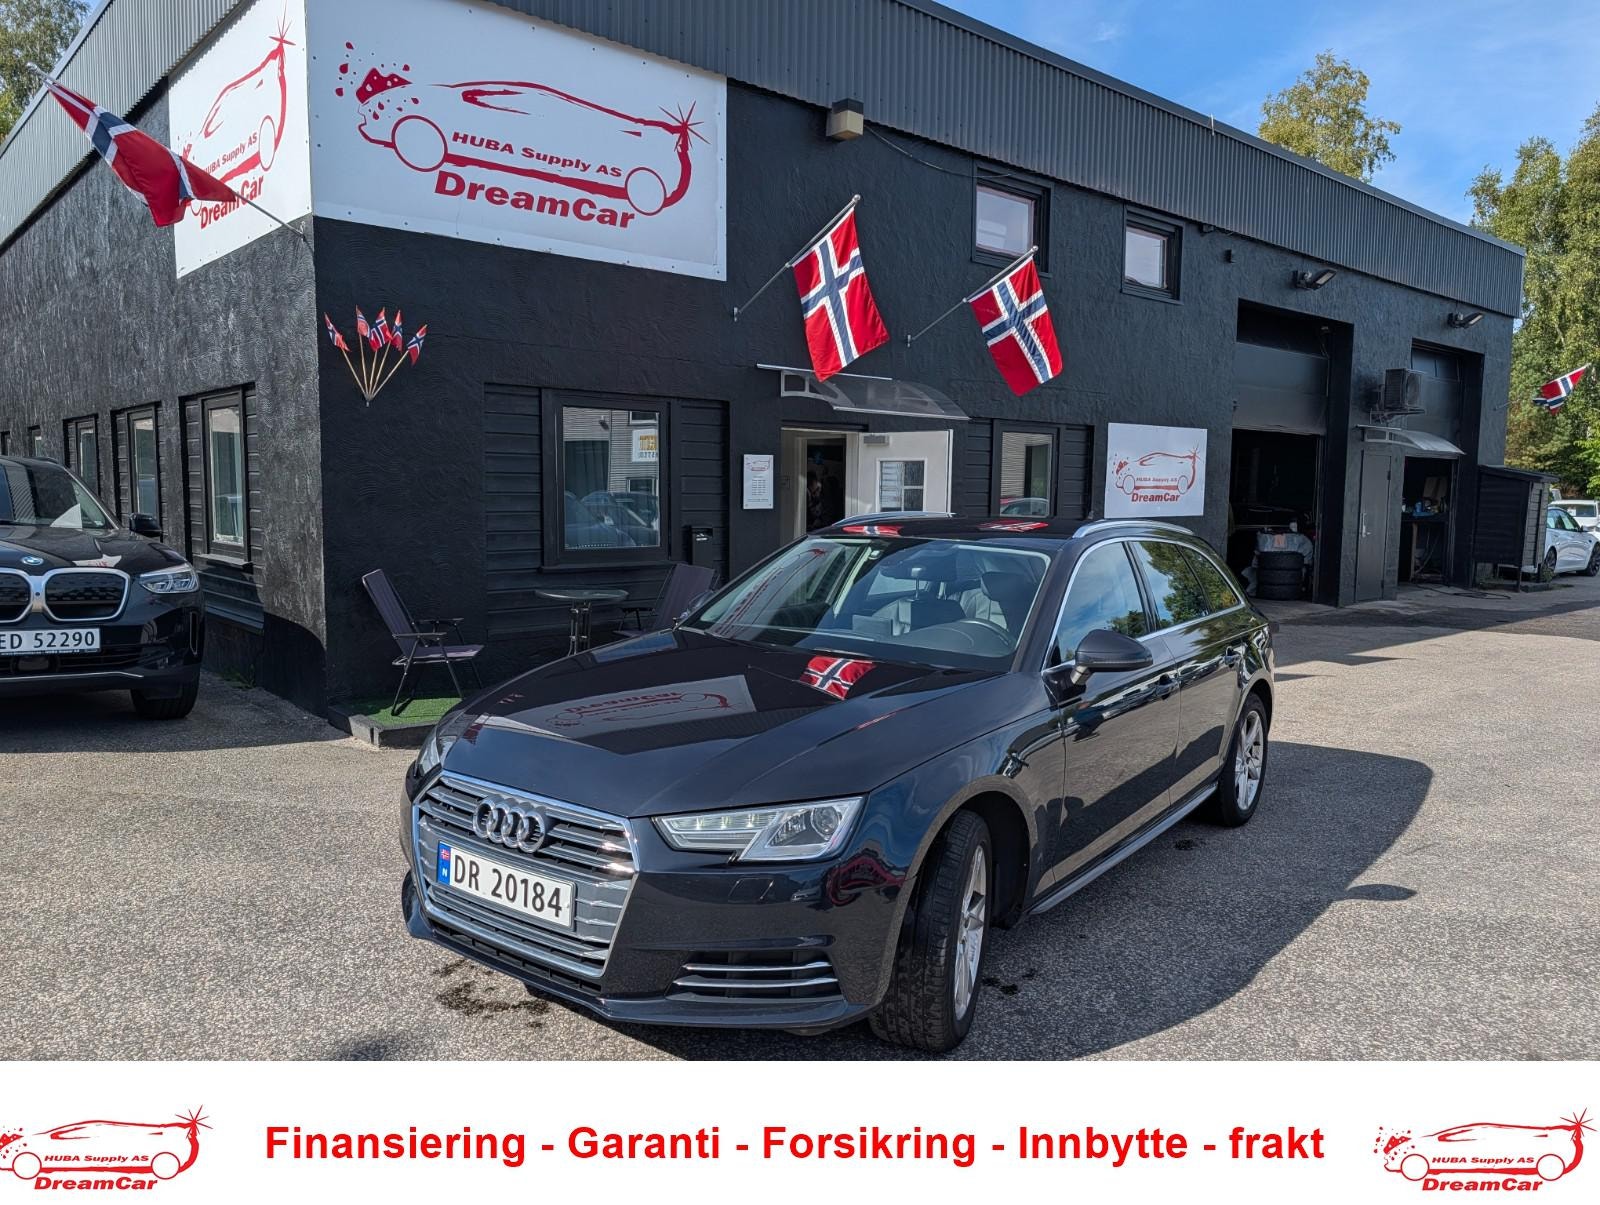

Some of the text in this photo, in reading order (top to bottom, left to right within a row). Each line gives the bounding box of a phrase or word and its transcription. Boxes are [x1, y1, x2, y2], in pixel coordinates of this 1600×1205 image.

[222, 142, 246, 165] Supply
[247, 132, 258, 148] AS
[452, 131, 622, 178] HUBA Supply AS
[434, 170, 636, 229] DreamCar
[1131, 492, 1180, 502] DreamCar
[0, 631, 95, 650] ED 52290
[441, 867, 448, 878] N
[453, 854, 562, 918] DR 20184
